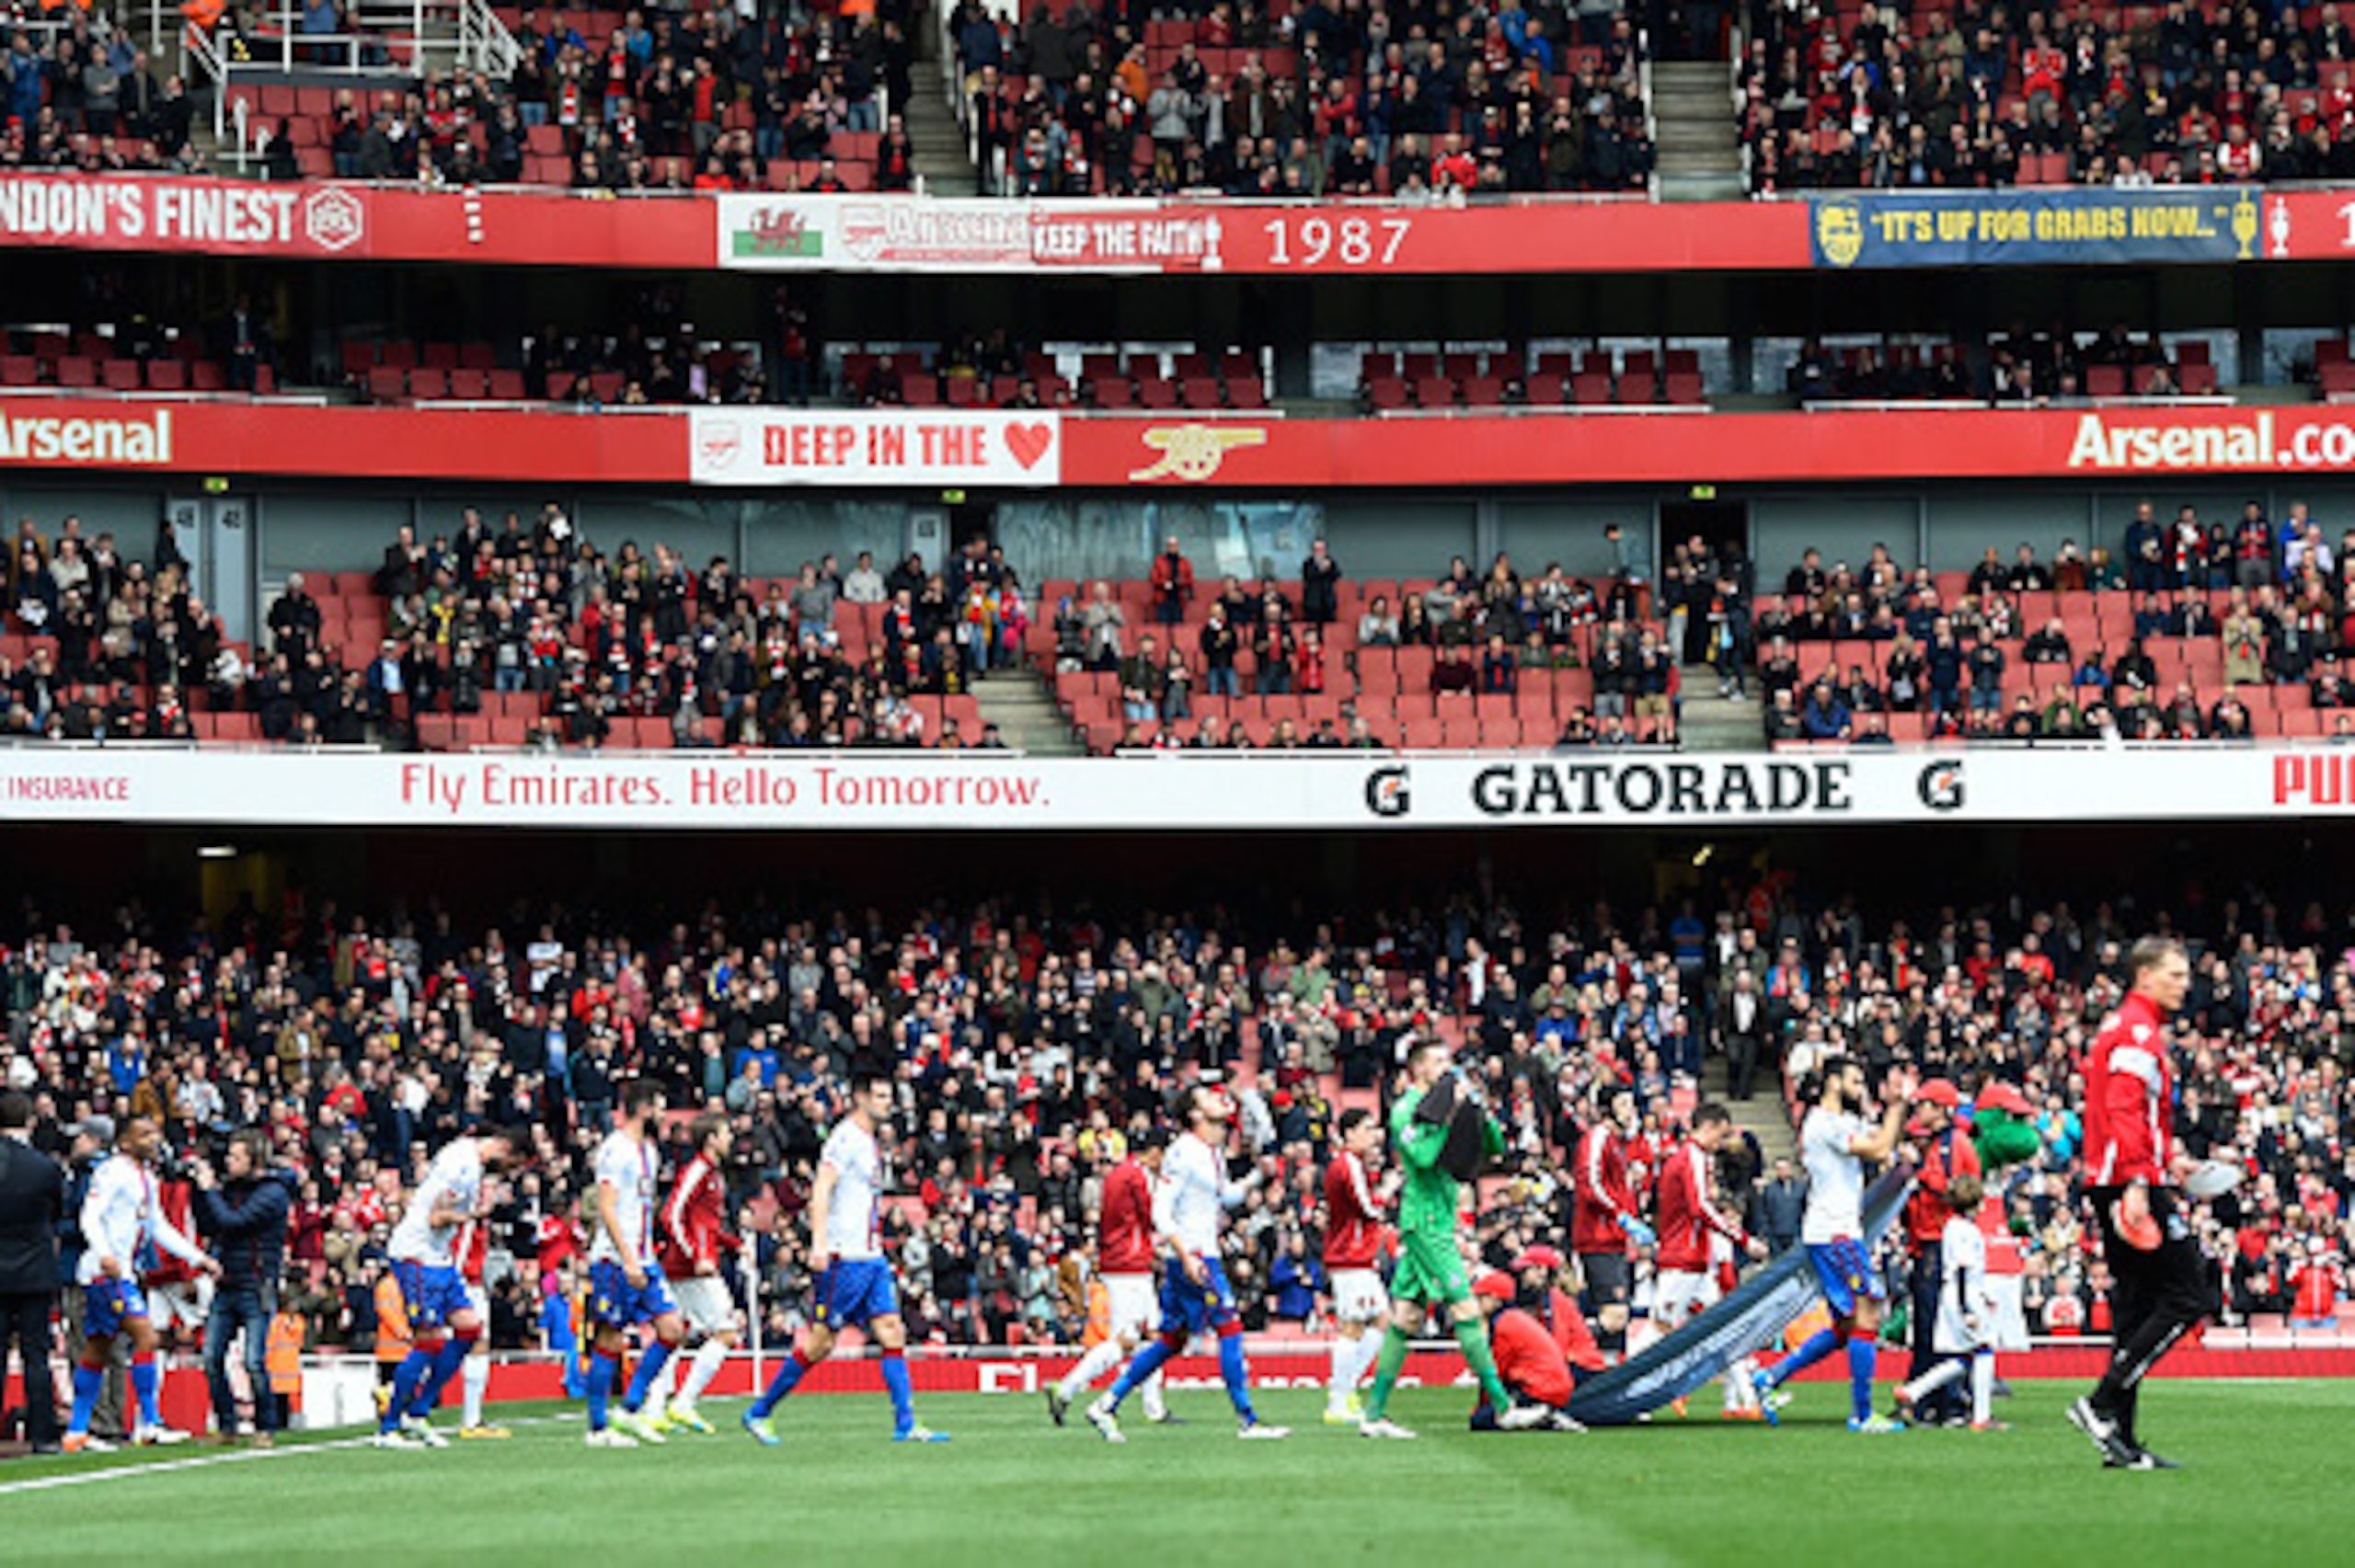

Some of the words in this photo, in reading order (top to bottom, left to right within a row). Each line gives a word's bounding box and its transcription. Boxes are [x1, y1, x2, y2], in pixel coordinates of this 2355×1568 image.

[155, 185, 299, 243] FINEST
[1093, 221, 1137, 258] THE
[1936, 209, 1976, 242] UP
[1979, 208, 2031, 242] FOR
[2036, 206, 2128, 241] GRABS
[1263, 216, 1412, 265] 1987
[764, 425, 856, 466] DEEP
[867, 425, 906, 466] IN
[916, 426, 988, 466] THE
[7, 775, 132, 802] INSURANCE
[401, 762, 467, 814] Fly
[481, 762, 674, 806] Emirates.
[690, 768, 798, 806] Hello
[813, 768, 1051, 806] Tomorrow.
[1365, 764, 1411, 817] G
[1470, 760, 1853, 815] GATORADE
[1916, 759, 1967, 812] G
[2273, 754, 2355, 805] PU
